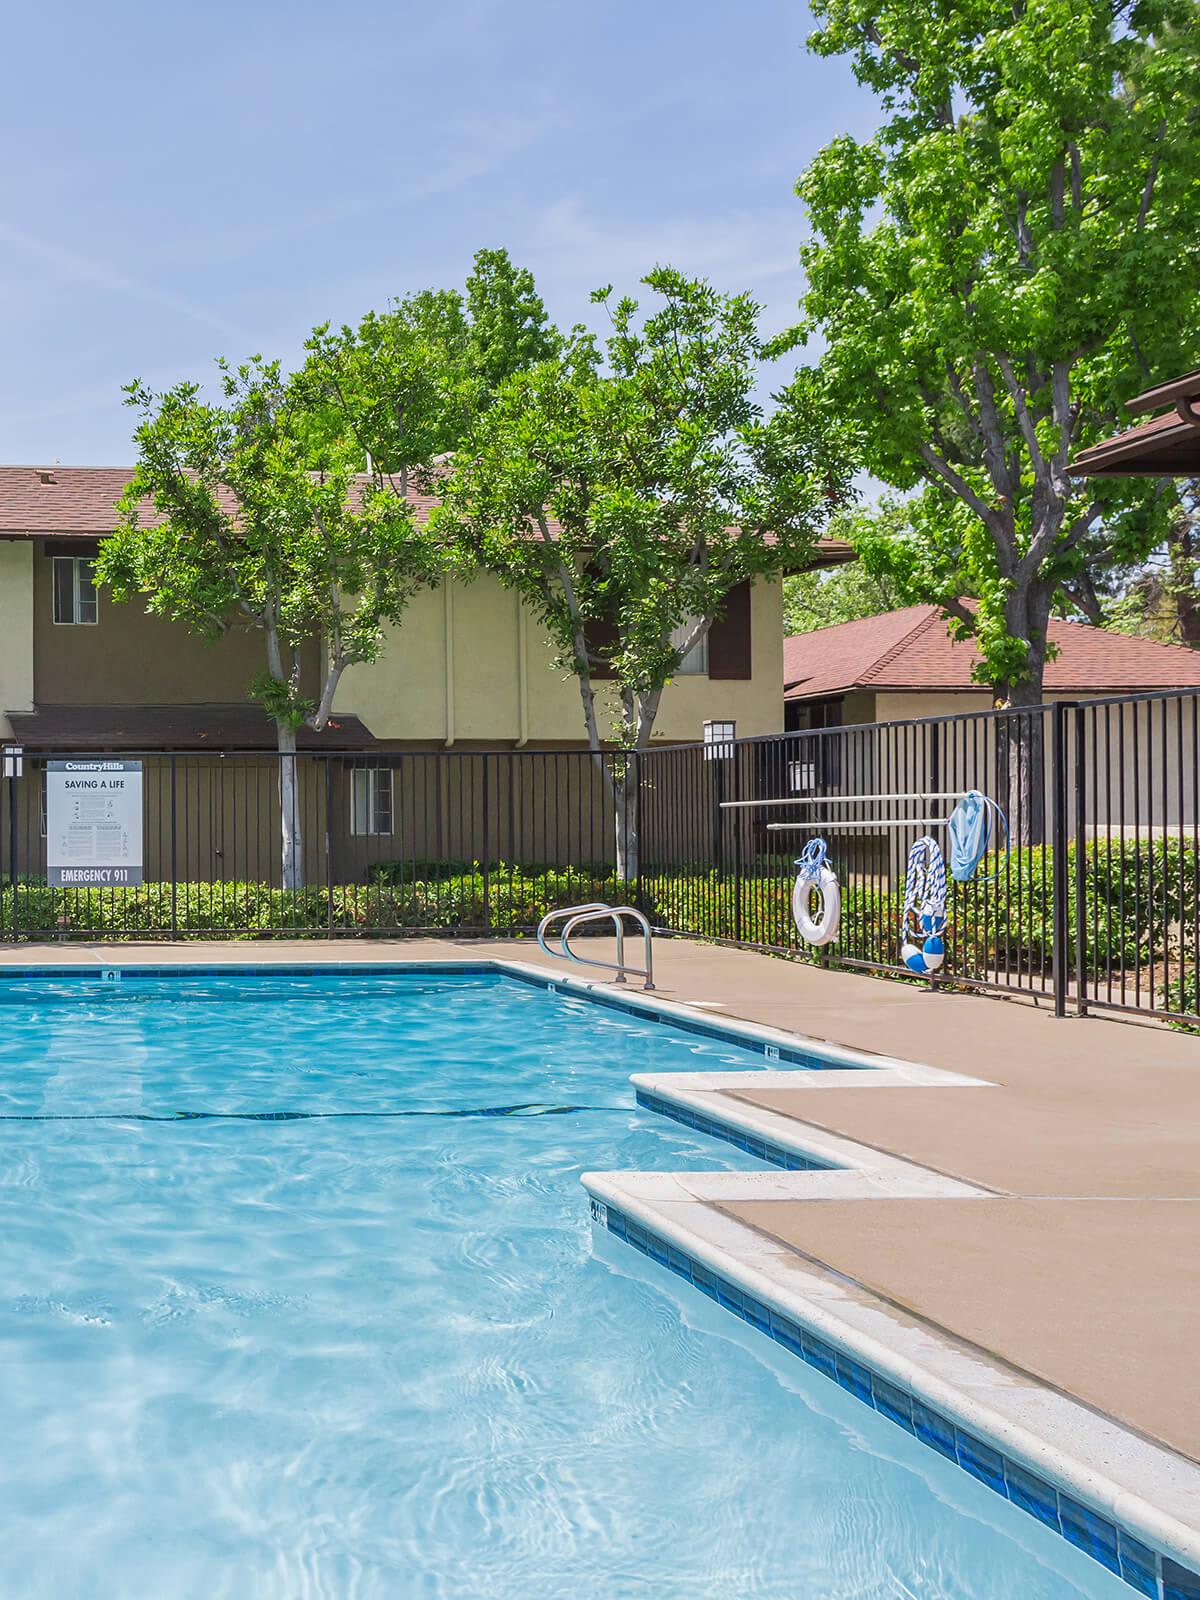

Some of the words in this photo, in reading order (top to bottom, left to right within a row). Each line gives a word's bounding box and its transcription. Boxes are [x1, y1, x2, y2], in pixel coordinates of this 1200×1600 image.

[64, 780, 98, 789] SAVING
[100, 780, 107, 789] A
[109, 780, 125, 789] LIFE
[61, 869, 112, 882] EMERGENCY
[114, 869, 128, 882] 911
